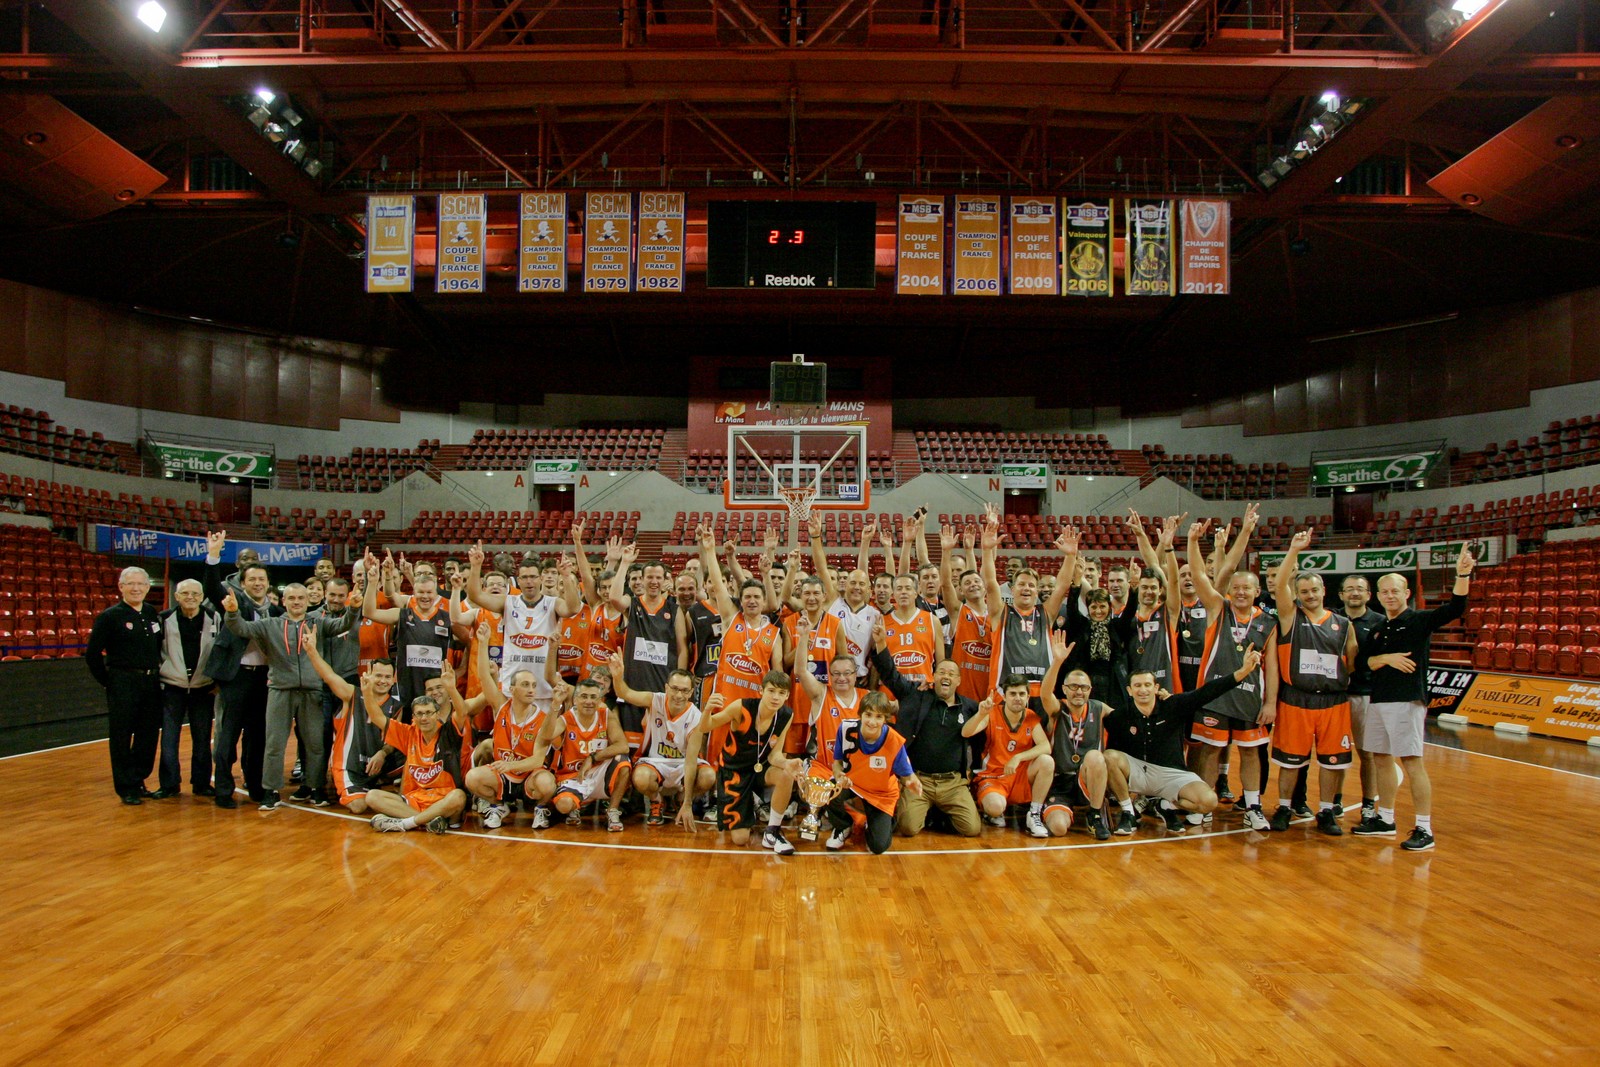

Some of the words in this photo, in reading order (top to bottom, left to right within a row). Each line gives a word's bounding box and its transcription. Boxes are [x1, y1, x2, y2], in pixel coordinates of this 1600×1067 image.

[444, 197, 480, 214] SCM
[525, 194, 561, 213] SCM
[591, 194, 627, 213] SCM
[645, 194, 680, 212] SCM
[911, 204, 932, 214] MSB
[968, 203, 988, 212] MSB
[1023, 205, 1043, 215] MSB
[1078, 208, 1098, 217] MSB
[1142, 210, 1158, 219] MSB
[384, 226, 397, 237] 14
[769, 230, 780, 244] 2
[1027, 243, 1039, 251] DE
[1014, 252, 1052, 260] FRANCE
[380, 268, 398, 276] MSB
[442, 264, 479, 272] FRANCE
[440, 279, 480, 290] 1964
[522, 278, 561, 289] 1978
[587, 278, 627, 288] 1979
[639, 277, 679, 288] 1982
[765, 274, 816, 286] Reebok
[901, 275, 940, 287] 2004
[956, 279, 997, 290] 2006
[1014, 276, 1053, 289] 2009
[1068, 279, 1107, 291] 2006
[1134, 280, 1168, 291] 2009
[1186, 282, 1224, 294] 2012
[755, 401, 771, 410] LA
[830, 401, 865, 411] MANS
[161, 454, 213, 471] Sarthe
[514, 474, 524, 487] A
[579, 474, 589, 487] A
[1327, 469, 1381, 483] Sarthe
[844, 485, 858, 493] LNB
[989, 478, 1000, 491] N
[1056, 479, 1067, 492] N
[114, 539, 123, 550] Le
[178, 546, 186, 557] Le
[258, 552, 269, 562] Le
[269, 544, 318, 563] Maine
[1432, 552, 1460, 563] Sahe
[1359, 558, 1391, 568] Sarthe
[525, 617, 534, 629] 7
[564, 627, 571, 639] 4
[899, 632, 913, 646] 18
[516, 634, 547, 646] Gaulois
[559, 646, 582, 657] aulois
[967, 642, 992, 655] Gaulo
[731, 654, 761, 674] Gaulois
[893, 653, 924, 666] Gaulois
[1449, 672, 1472, 687] FM
[1432, 686, 1463, 696] OFFICIELLE
[1568, 683, 1588, 693] Des
[1428, 696, 1456, 708] MSB
[1474, 689, 1543, 707] TABLAPIZZA
[1553, 694, 1574, 705] qui
[1552, 705, 1566, 714] de
[1567, 707, 1579, 716] la
[1007, 740, 1017, 752] 6
[1341, 735, 1350, 750] 4
